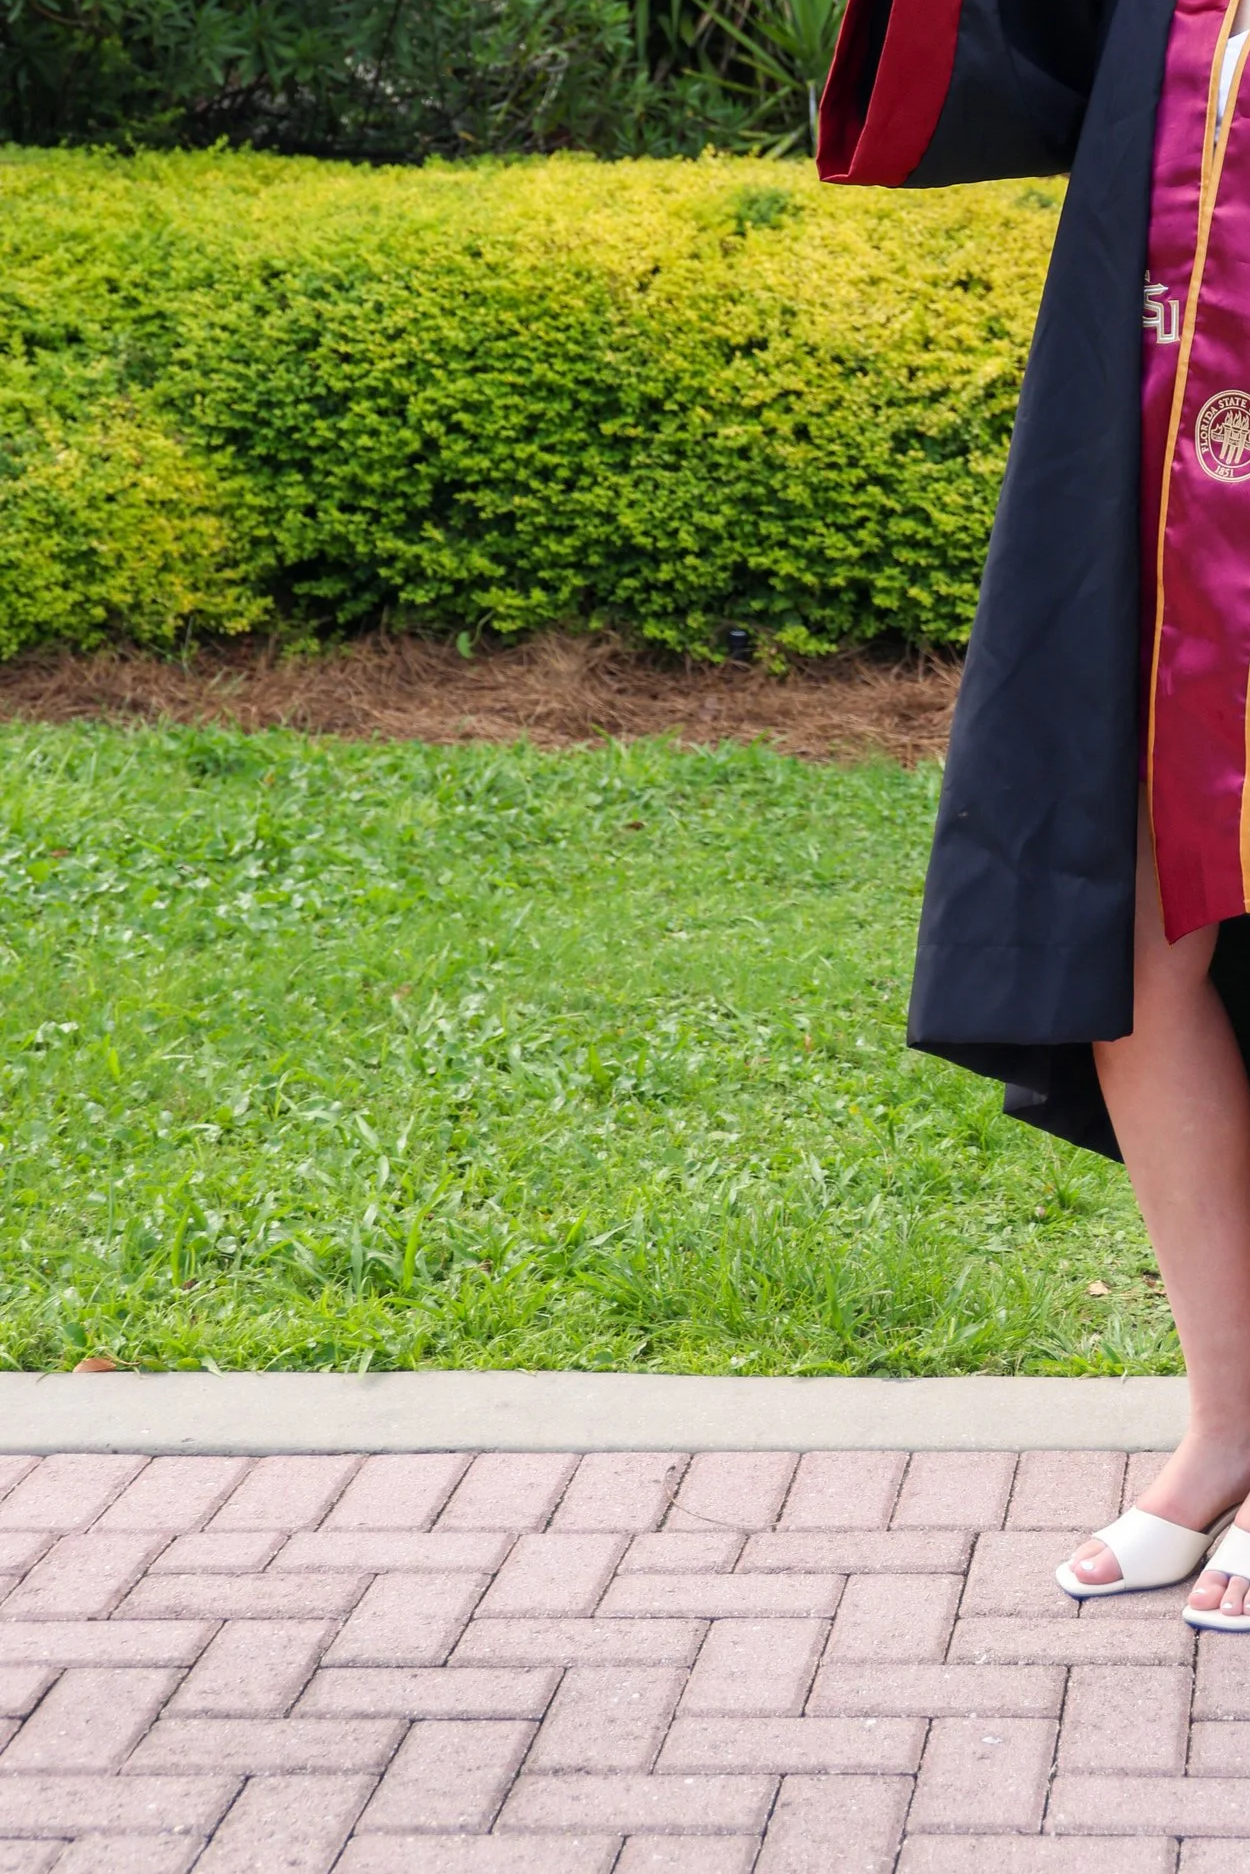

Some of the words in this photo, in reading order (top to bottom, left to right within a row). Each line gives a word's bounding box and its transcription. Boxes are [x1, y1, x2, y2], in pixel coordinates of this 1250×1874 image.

[1143, 269, 1181, 344] SU
[1200, 406, 1219, 454] FLORIDA
[1217, 396, 1248, 409] STATE
[1214, 465, 1235, 477] 1851
